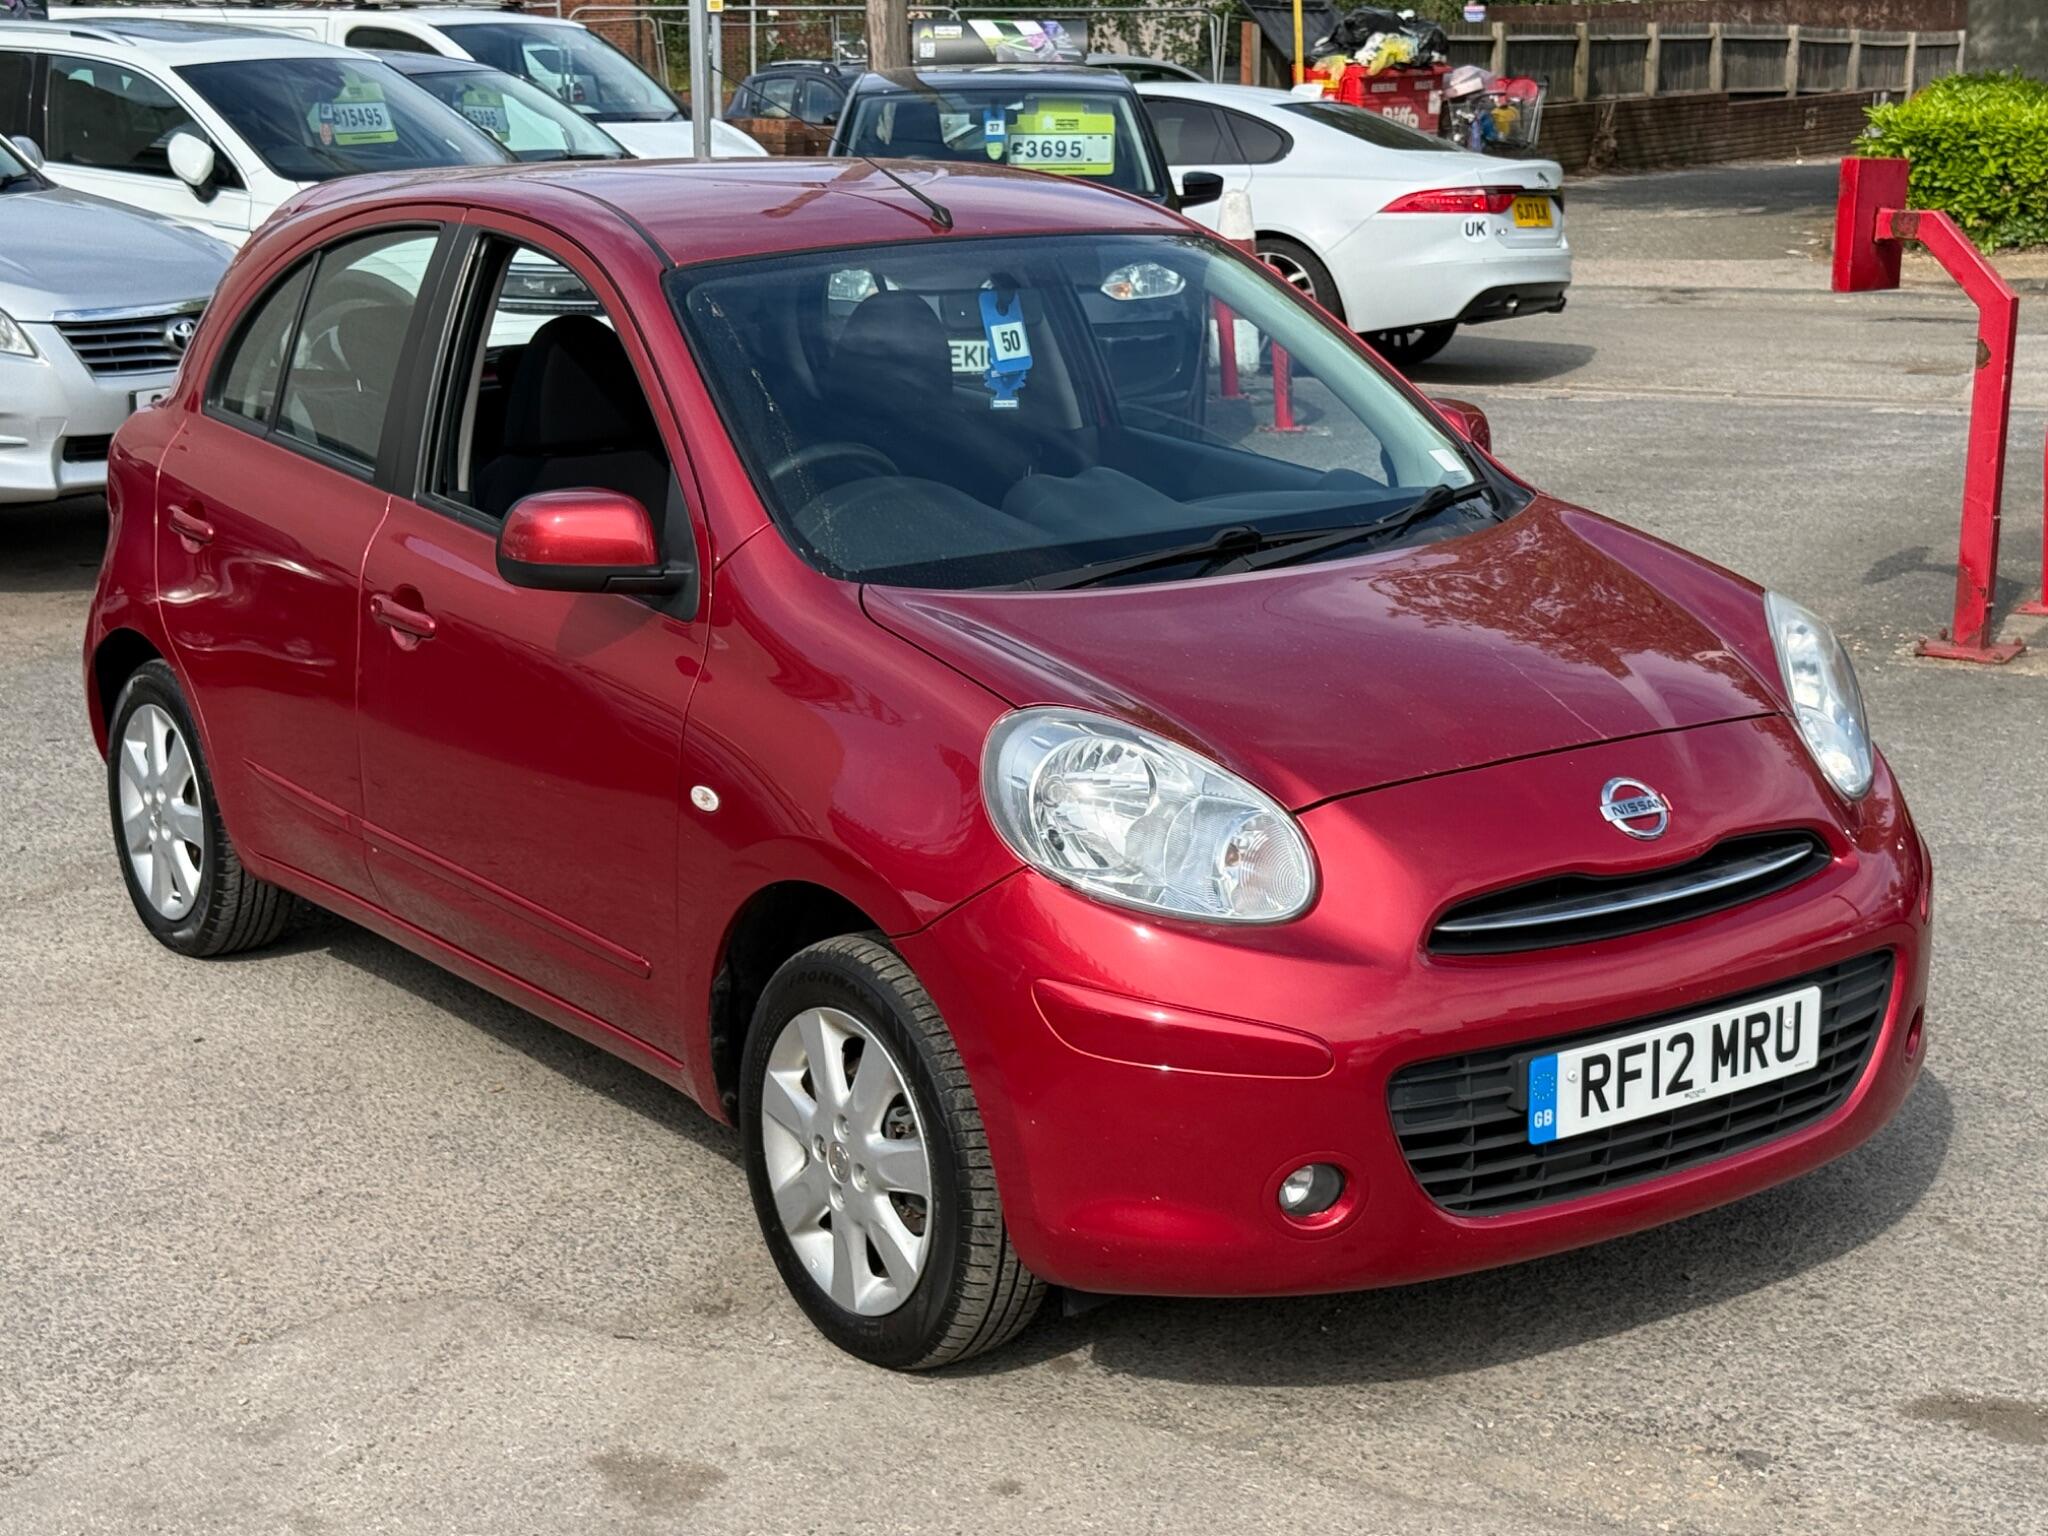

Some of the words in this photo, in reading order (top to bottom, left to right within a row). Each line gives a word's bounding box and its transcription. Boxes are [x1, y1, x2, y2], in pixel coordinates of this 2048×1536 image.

[1012, 140, 1083, 158] £3695
[1465, 221, 1487, 237] UK
[1001, 329, 1021, 353] 50
[1611, 799, 1664, 816] NISSAN
[1580, 1032, 1694, 1119] RF12
[1710, 1000, 1802, 1084] MRU
[1533, 1109, 1553, 1128] GB
